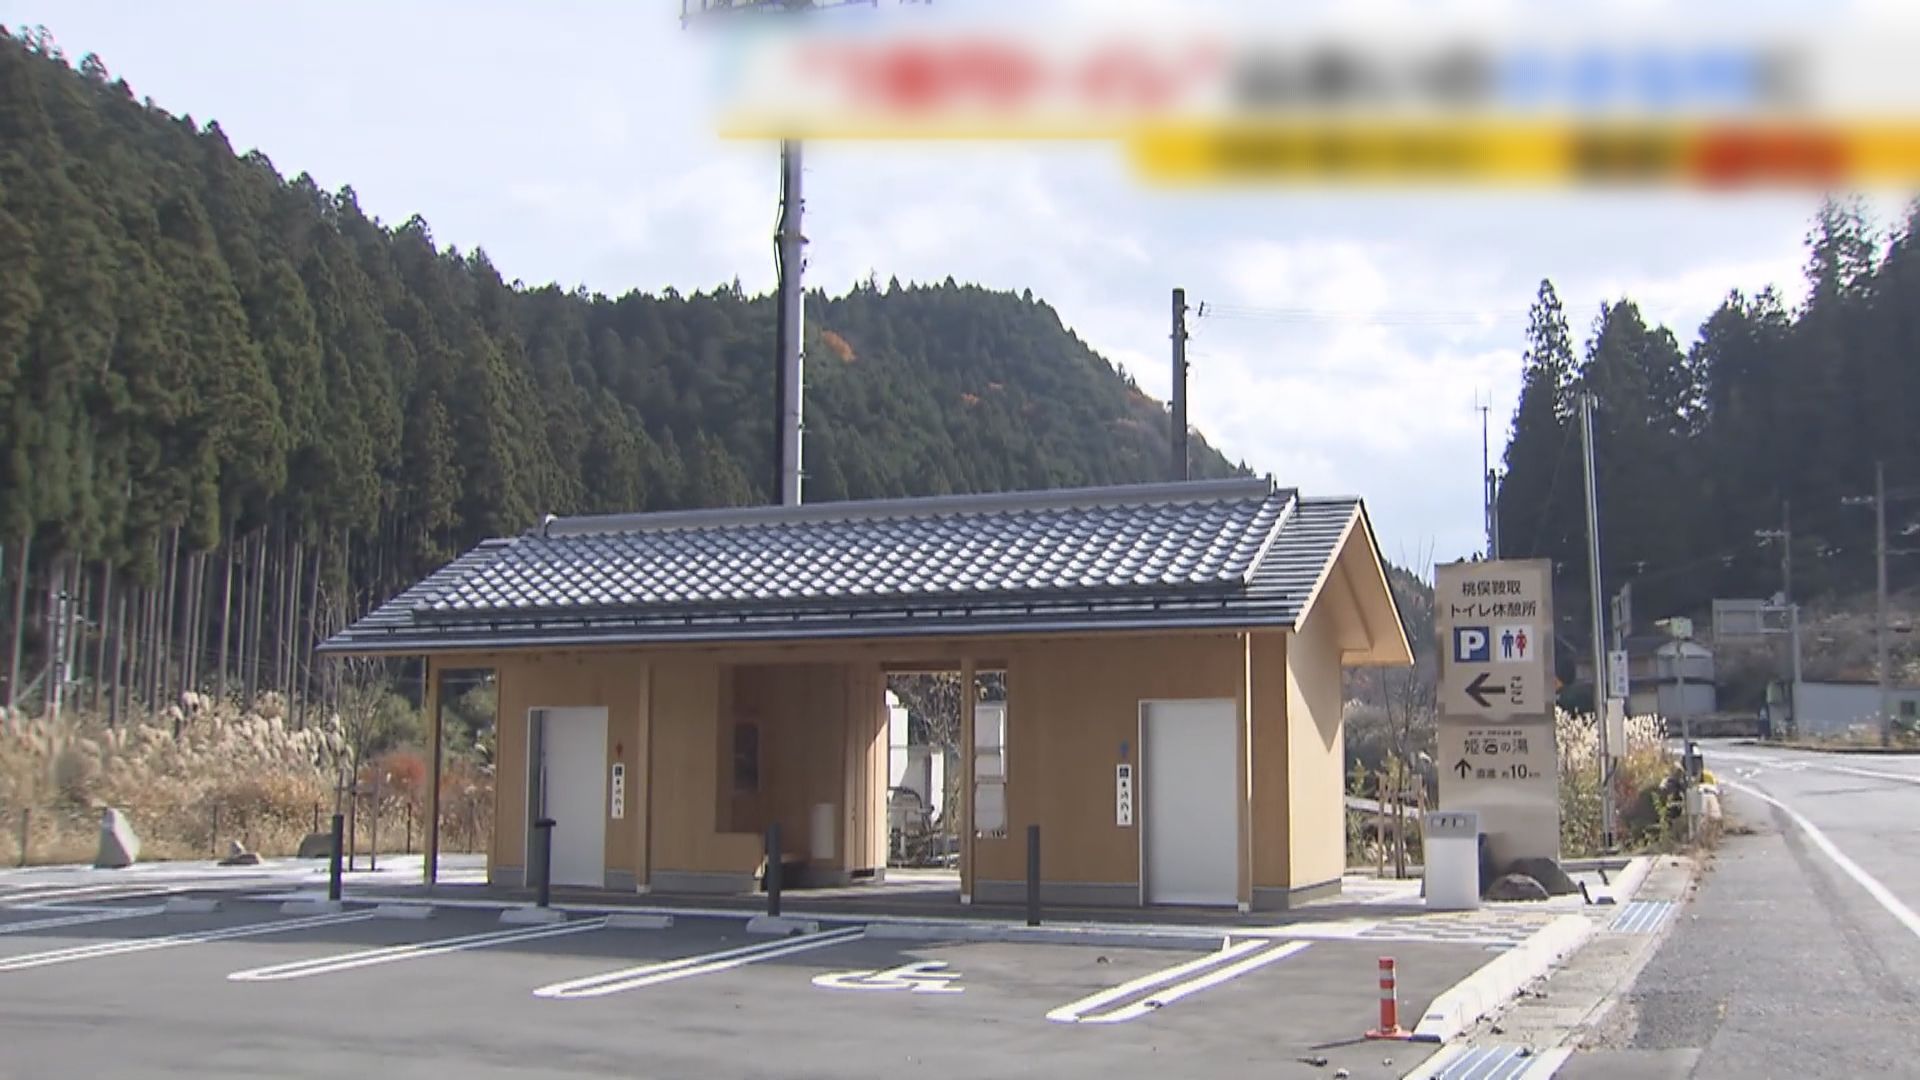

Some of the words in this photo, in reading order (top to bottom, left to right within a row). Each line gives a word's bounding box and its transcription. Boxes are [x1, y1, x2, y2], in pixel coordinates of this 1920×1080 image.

[1451, 600, 1536, 618] トイレ休憩所
[1460, 630, 1486, 660] P
[1510, 675, 1524, 705] ここ
